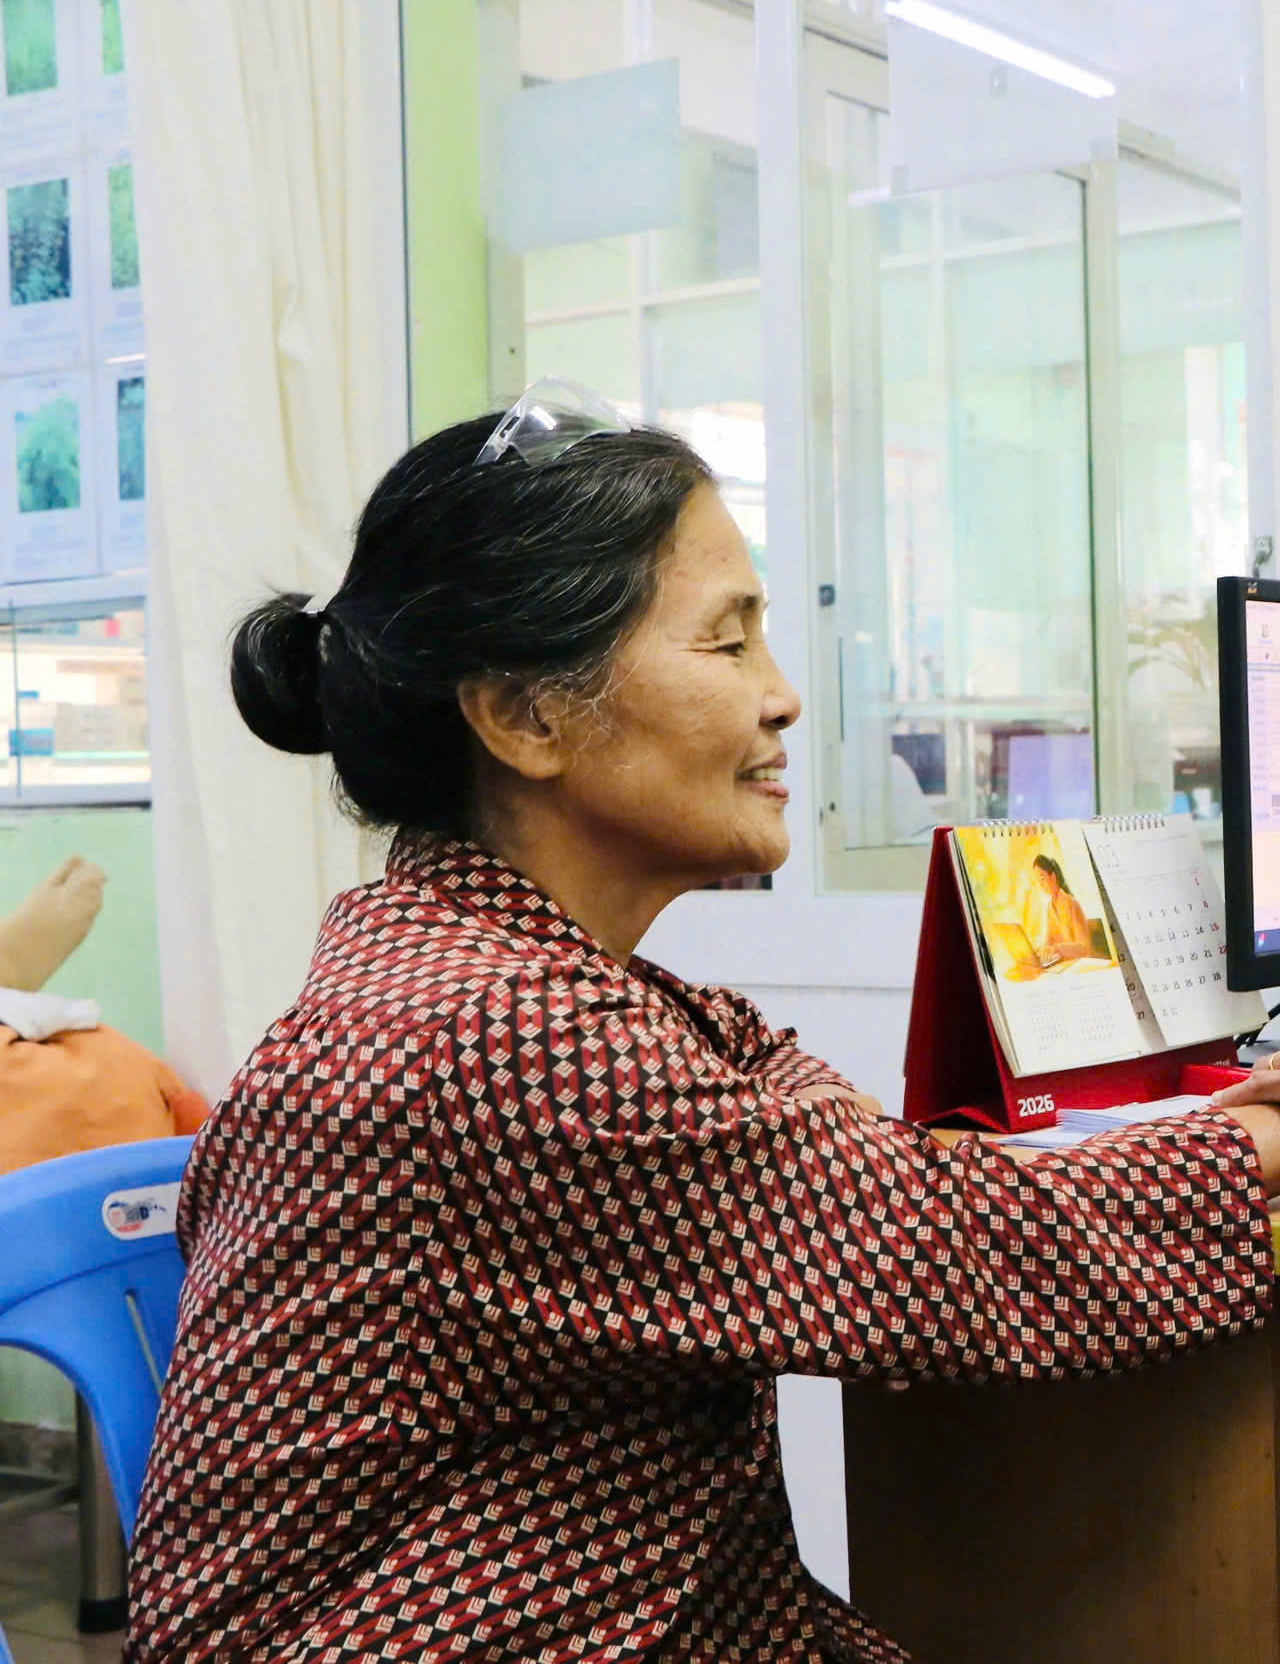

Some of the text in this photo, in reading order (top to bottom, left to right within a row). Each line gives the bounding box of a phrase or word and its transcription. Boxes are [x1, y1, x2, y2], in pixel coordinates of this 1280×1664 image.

[1187, 903, 1193, 911] 7
[1203, 900, 1209, 908] 8
[1195, 926, 1205, 935] 14
[1210, 922, 1219, 931] 15
[1190, 951, 1199, 961] 20
[1203, 949, 1213, 959] 21
[1198, 975, 1206, 985] 27
[1212, 972, 1222, 981] 28
[1136, 1010, 1145, 1020] 27
[1017, 1094, 1055, 1118] 2026
